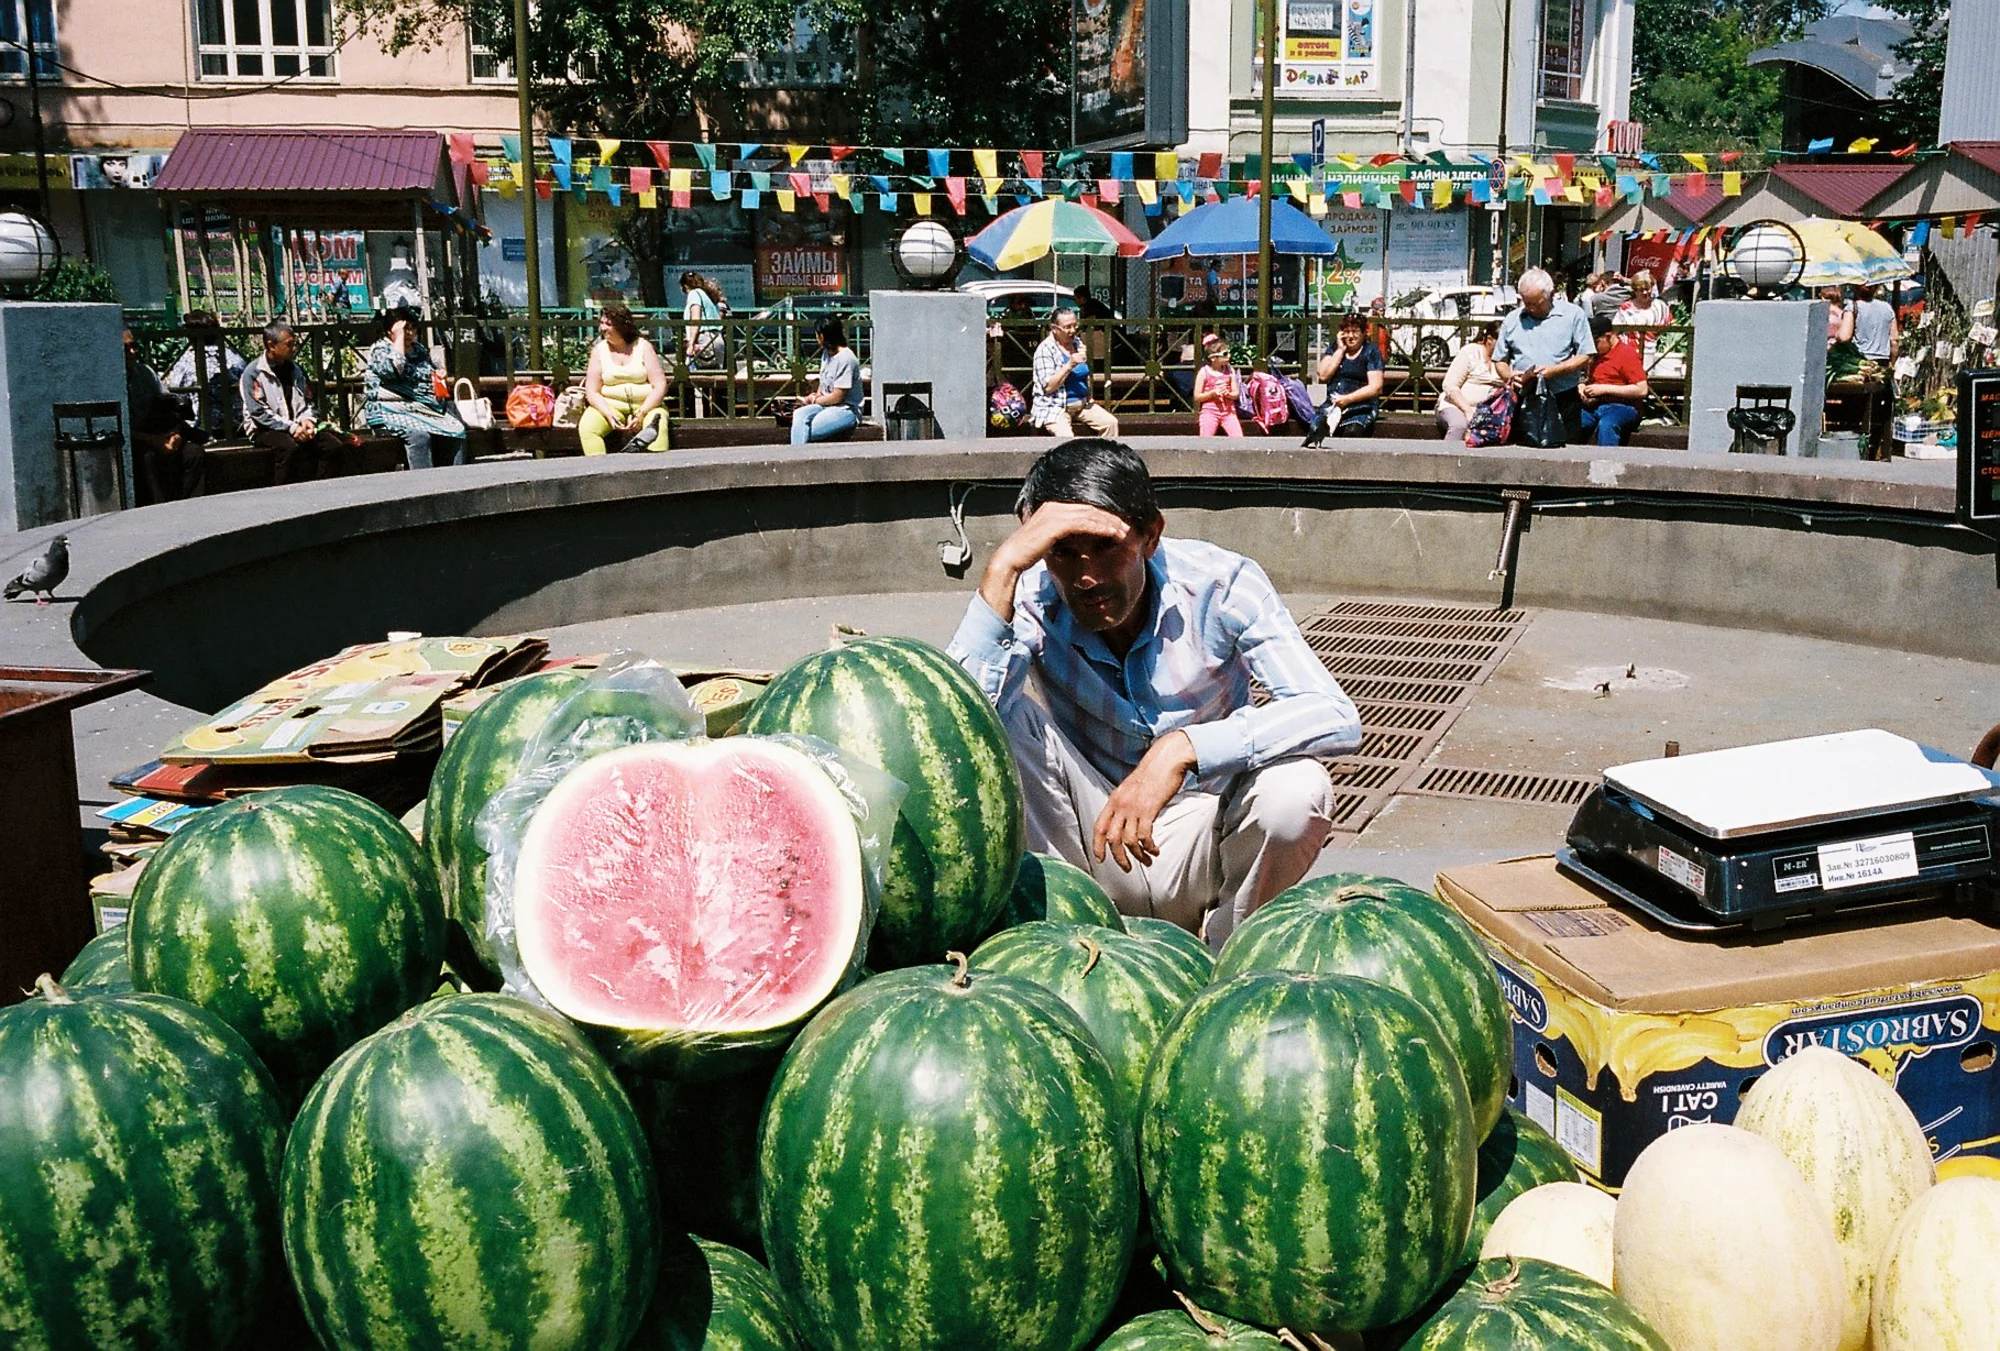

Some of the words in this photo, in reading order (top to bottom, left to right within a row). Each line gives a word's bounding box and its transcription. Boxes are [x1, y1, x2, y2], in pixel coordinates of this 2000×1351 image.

[1410, 169, 1450, 180] ЗАЙМЫ
[770, 247, 838, 274] ЗАЙМЫ
[761, 274, 774, 286] НА
[813, 273, 839, 287] ЦЕЛИ
[1981, 466, 2000, 475] СТО
[1673, 1091, 1718, 1112] CAT
